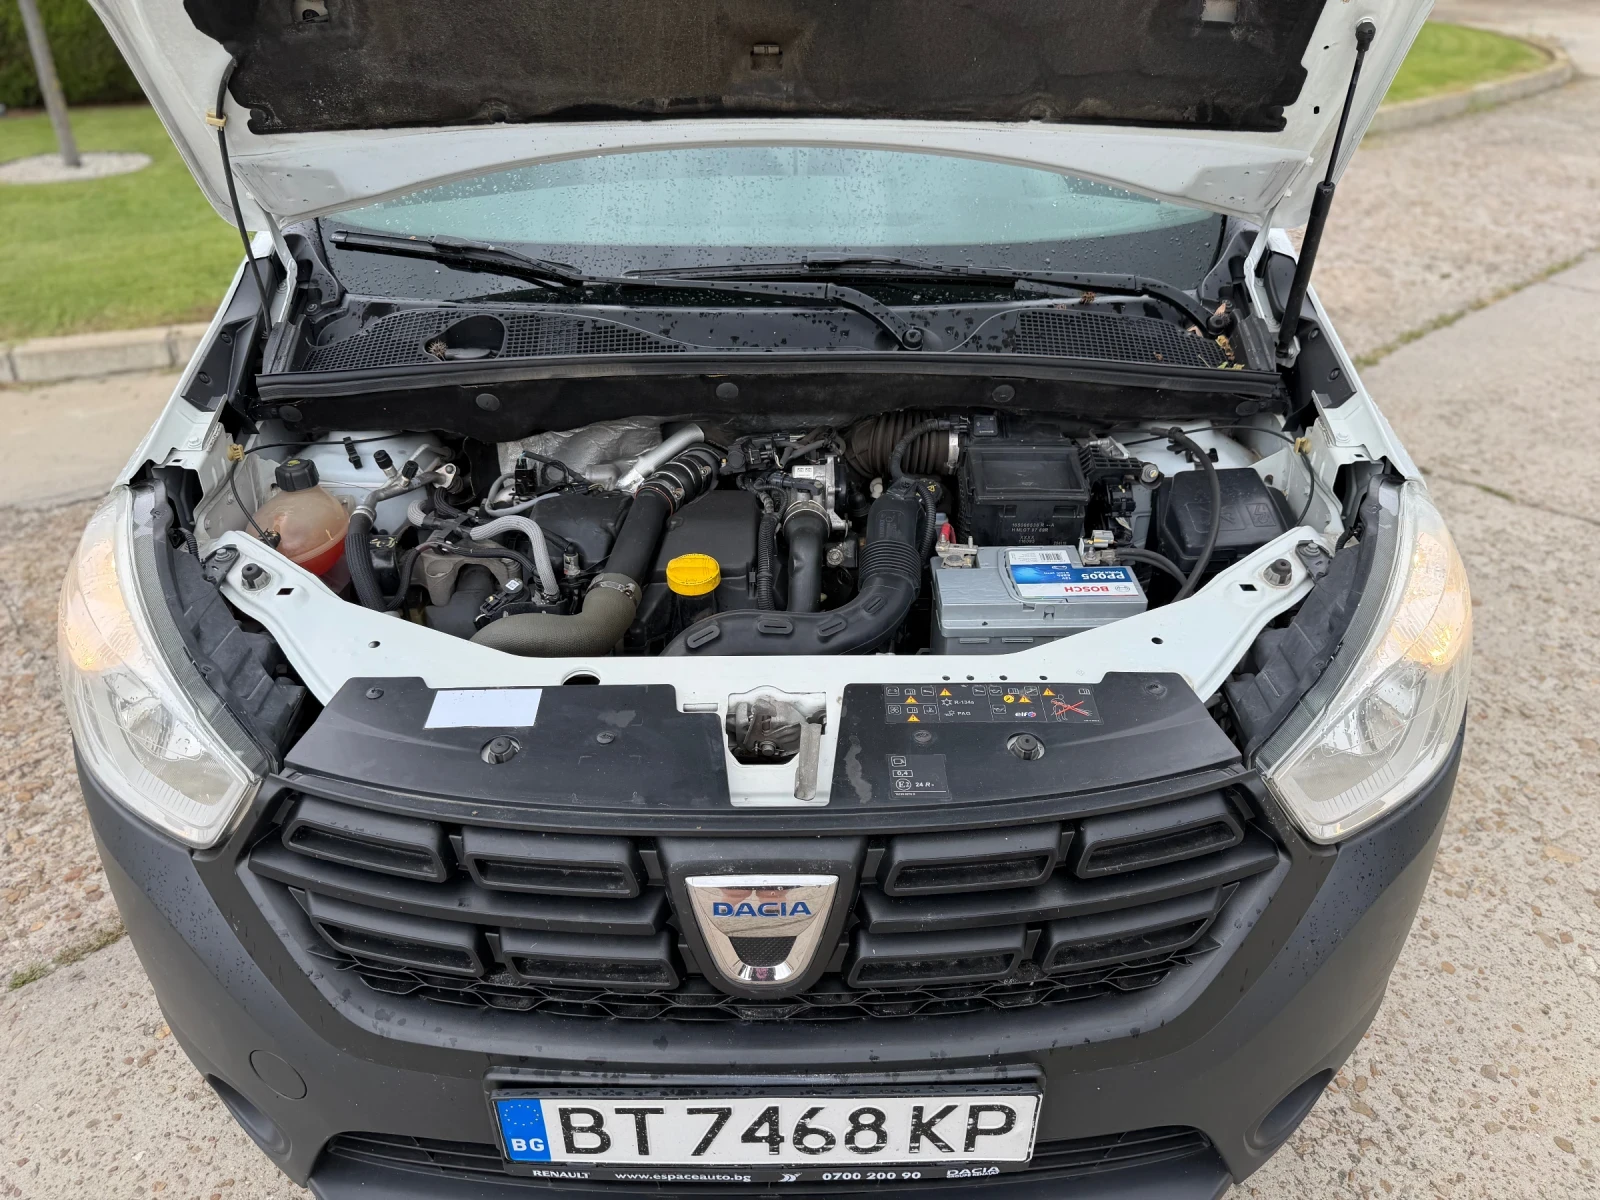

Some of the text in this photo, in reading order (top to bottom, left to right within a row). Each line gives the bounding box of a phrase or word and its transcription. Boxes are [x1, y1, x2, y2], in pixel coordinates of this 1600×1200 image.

[712, 901, 811, 918] DACIA
[558, 1104, 1017, 1156] BT 7468 KP
[511, 1138, 545, 1152] BG
[532, 1169, 752, 1182] RENAULT www.espaceauto.bg
[821, 1171, 922, 1180] 0700 200 90
[946, 1166, 1000, 1177] DACIA
